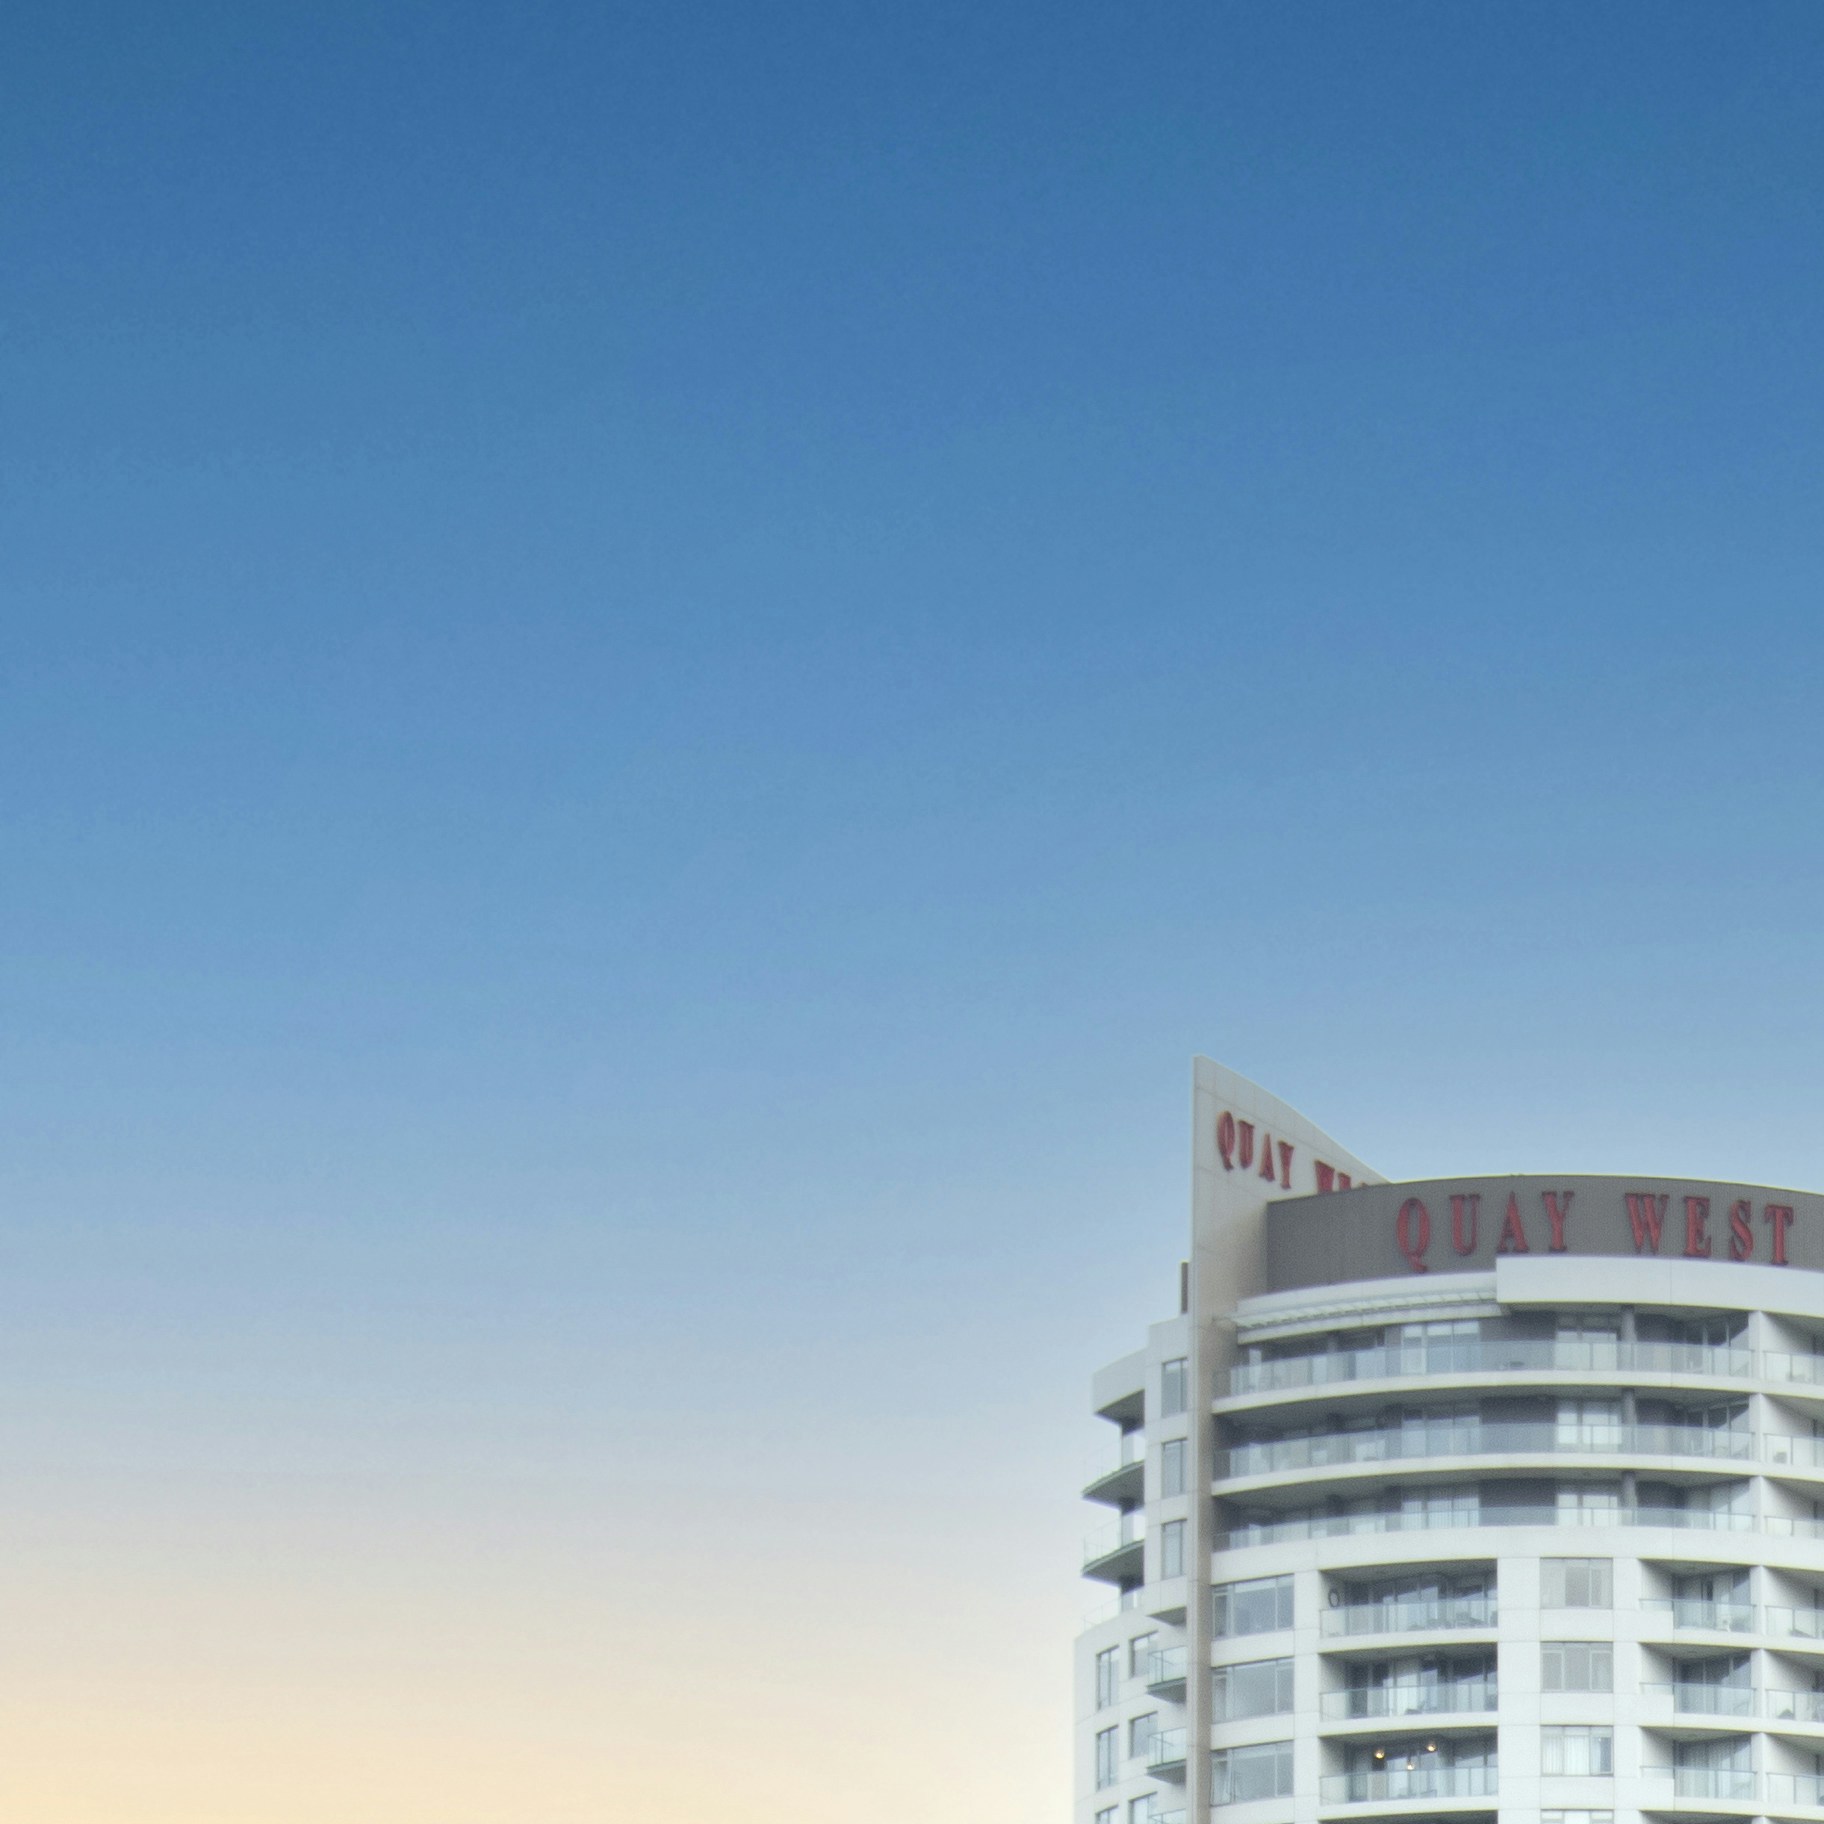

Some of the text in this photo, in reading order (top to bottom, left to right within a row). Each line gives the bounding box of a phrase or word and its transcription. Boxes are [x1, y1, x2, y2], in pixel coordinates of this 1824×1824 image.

[1217, 1110, 1295, 1190] QUAY
[1396, 1191, 1795, 1273] QUAY WEST
